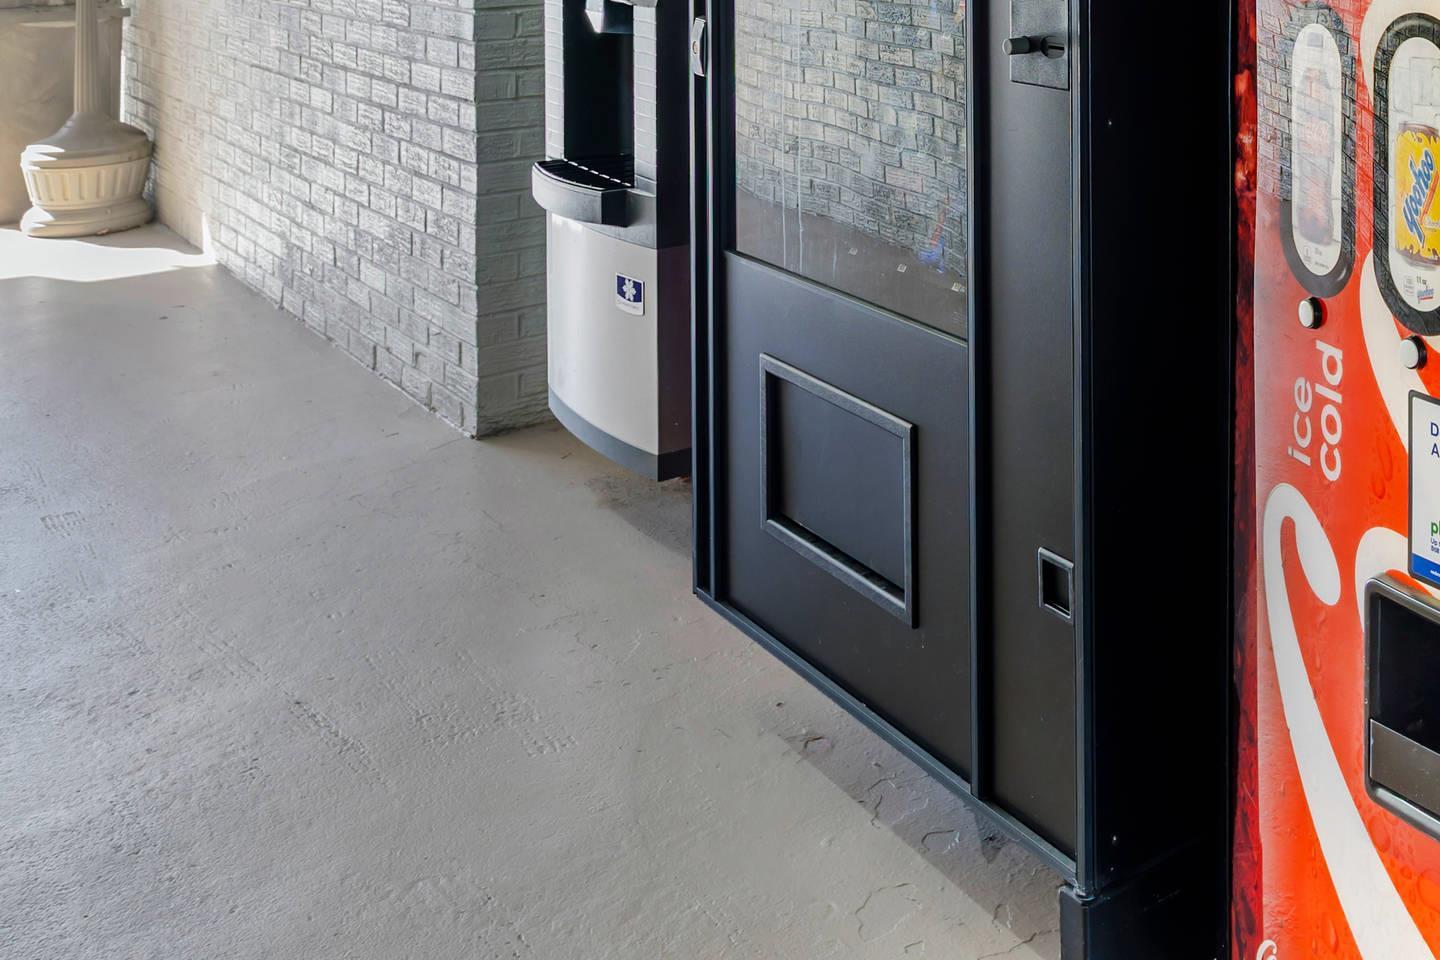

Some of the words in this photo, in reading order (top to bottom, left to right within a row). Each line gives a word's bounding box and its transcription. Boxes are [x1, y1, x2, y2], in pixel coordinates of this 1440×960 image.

[1288, 377, 1312, 466] ice
[1315, 340, 1343, 482] cold
[1431, 443, 1440, 458] A
